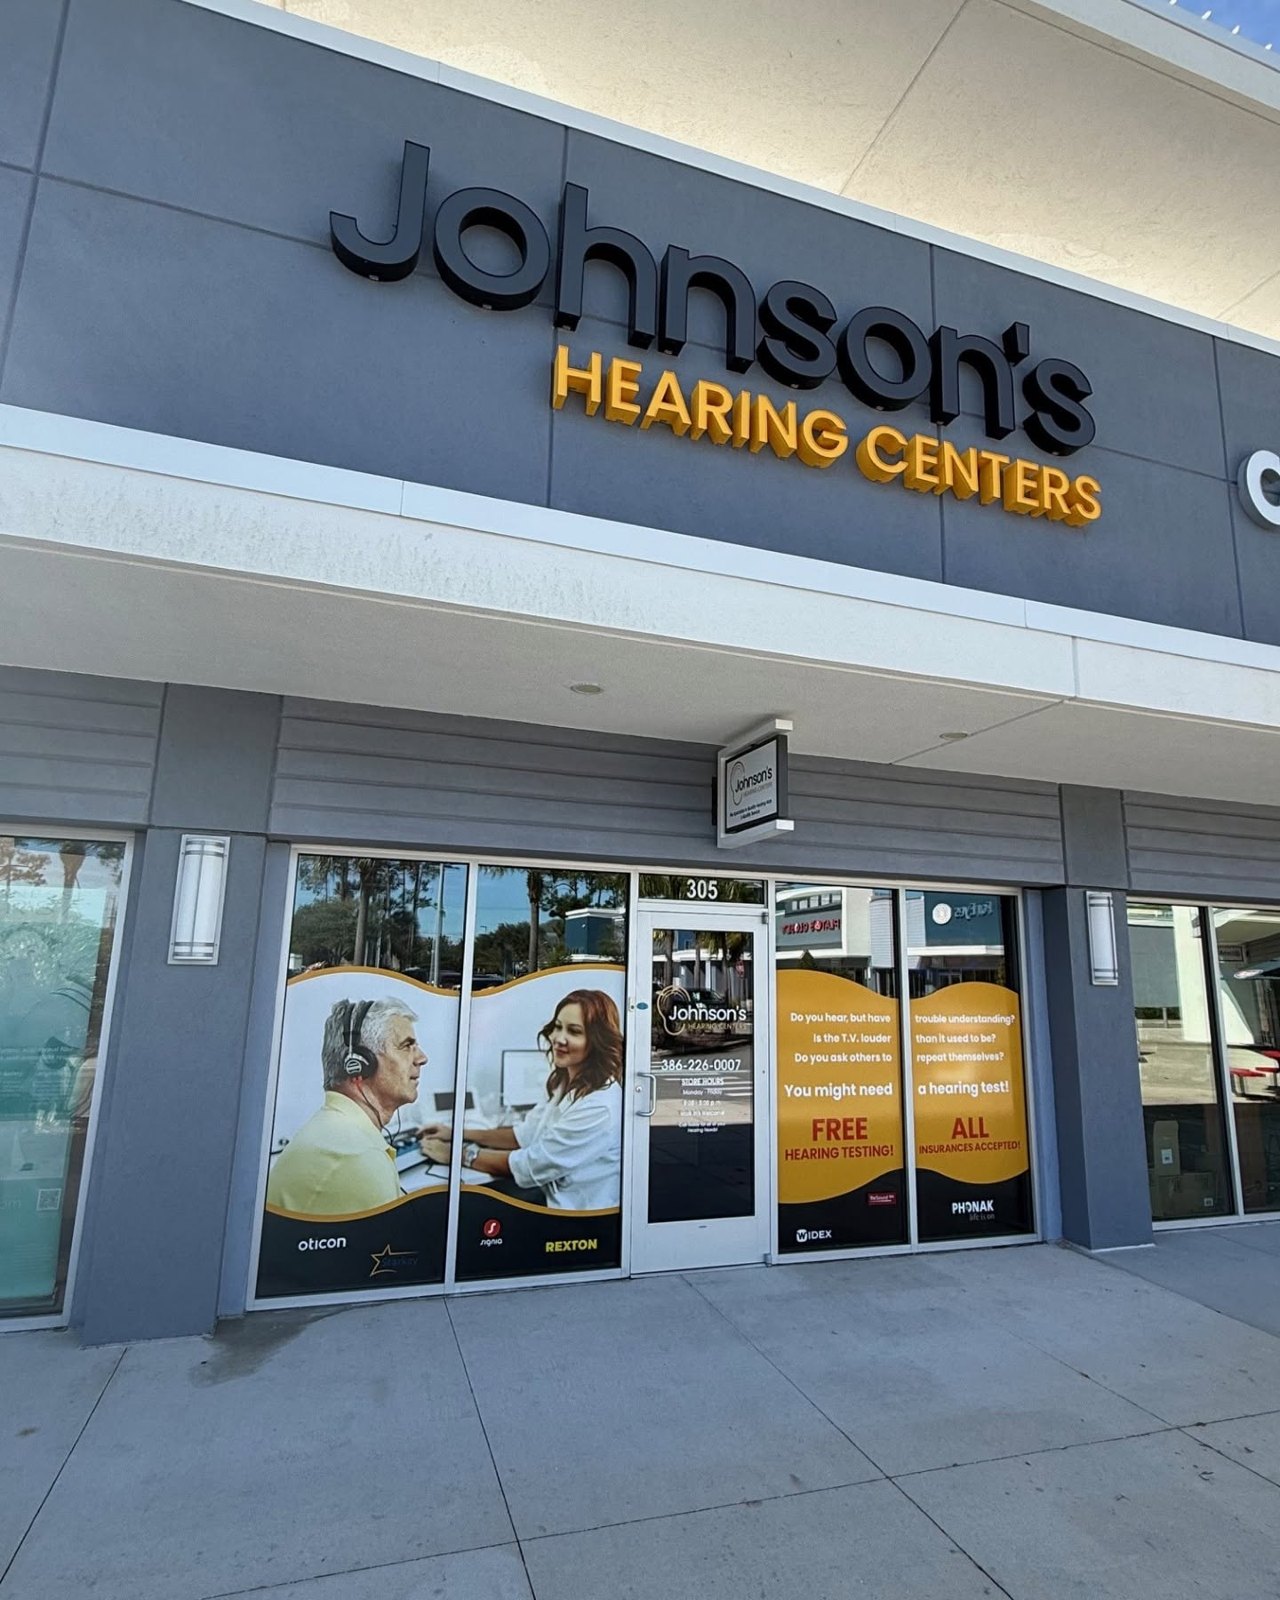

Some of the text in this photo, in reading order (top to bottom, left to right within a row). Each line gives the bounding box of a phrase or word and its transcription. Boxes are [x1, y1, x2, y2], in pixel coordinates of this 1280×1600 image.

[329, 140, 1096, 456] Johnson's
[553, 345, 1102, 526] HEARING CENTERS
[735, 766, 772, 793] Johnson's
[687, 879, 718, 899] 305
[668, 1005, 747, 1020] Johnson's
[790, 1013, 891, 1024] Do you hear, but have
[915, 1014, 1015, 1025] trouble understanding?
[823, 1033, 840, 1042] the
[841, 1033, 859, 1042] T.V.
[861, 1033, 891, 1043] louder
[916, 1033, 996, 1043] than it used to be?
[661, 1059, 741, 1071] 386-226-0007
[794, 1053, 892, 1065] Do you ask others to
[917, 1052, 1004, 1065] repeat themselves?
[784, 1083, 892, 1100] You might need
[918, 1080, 1009, 1097] a hearing test!
[812, 1117, 868, 1141] FREE
[951, 1117, 989, 1139] ALL
[785, 1145, 894, 1160] HEARING TESTING!
[919, 1141, 1021, 1154] INSURANCES ACCEPTED!
[951, 1200, 994, 1214] PHONAK
[480, 1238, 503, 1247] signia
[796, 1229, 832, 1242] WIDEX
[298, 1237, 347, 1251] oticon
[545, 1239, 598, 1253] REXTON
